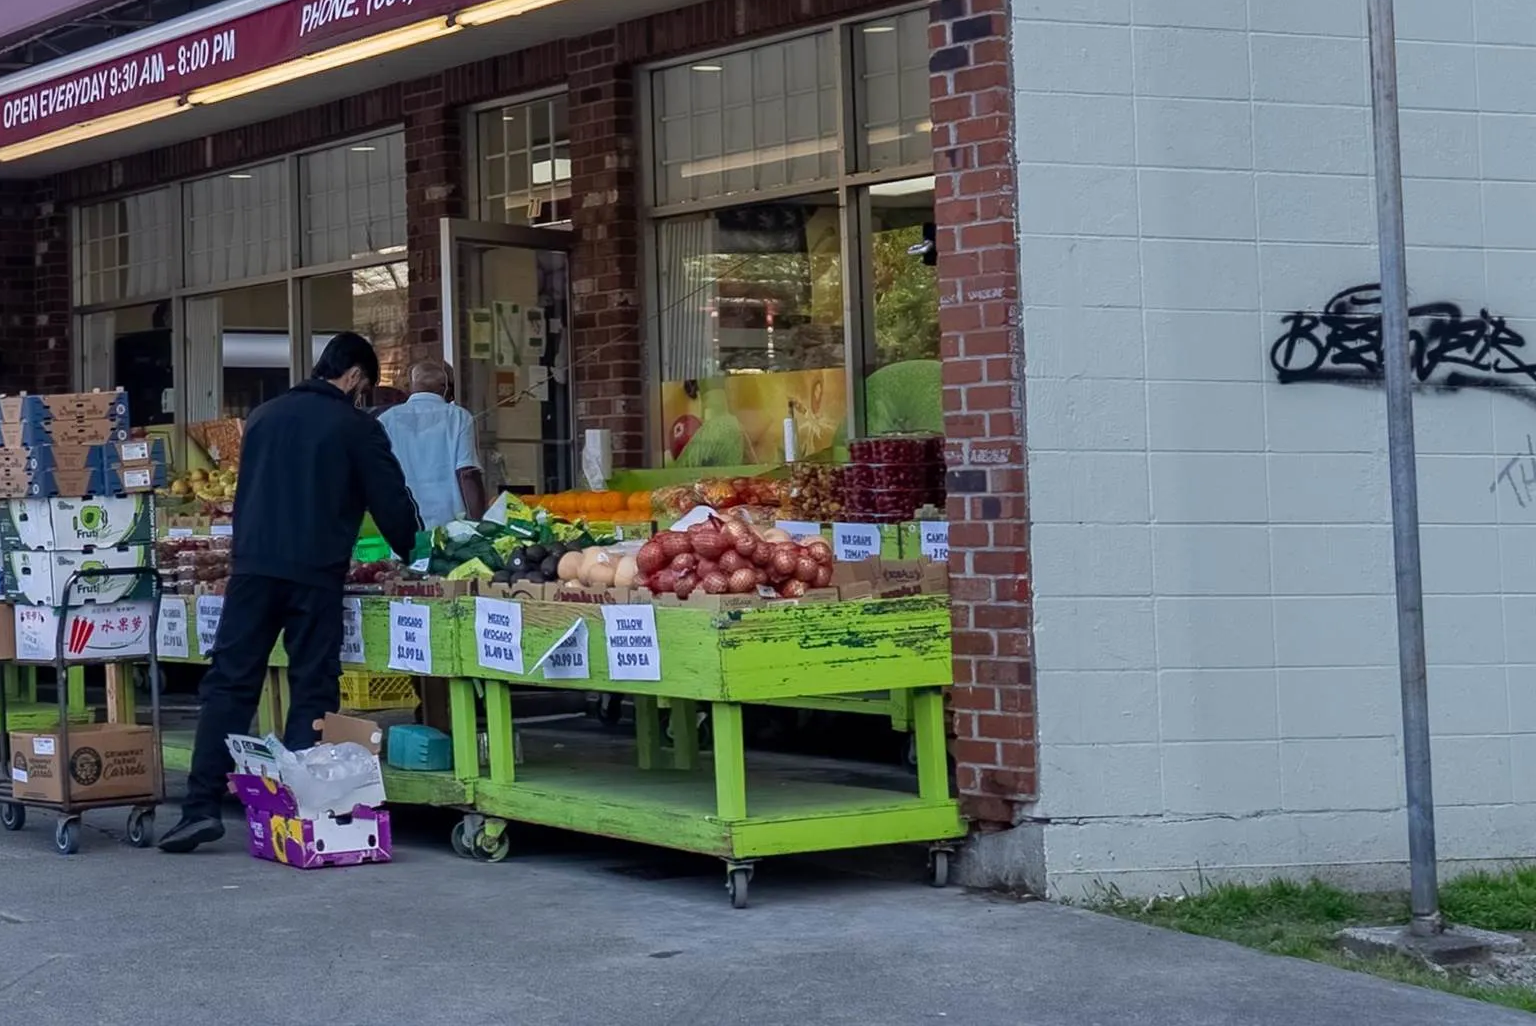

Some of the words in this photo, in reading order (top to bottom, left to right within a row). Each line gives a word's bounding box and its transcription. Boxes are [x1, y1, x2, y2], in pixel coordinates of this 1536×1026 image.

[3, 100, 39, 129] OPEN
[40, 69, 108, 119] EVERYDAY
[109, 60, 137, 96] 9:30
[139, 52, 165, 87] AM
[177, 38, 209, 75] 8:00
[211, 29, 236, 65] PM
[397, 615, 424, 629] AVOCADO
[487, 613, 511, 627] MEXICO
[616, 619, 643, 631] YELLOW
[405, 631, 416, 643] BAG
[483, 628, 513, 643] AVOCADO
[610, 636, 629, 647] MESH
[629, 636, 653, 647] ONION
[415, 648, 425, 662] EA
[503, 647, 514, 661] EA
[573, 654, 583, 666] LB
[639, 654, 649, 666] EA
[103, 763, 146, 781] Carrots
